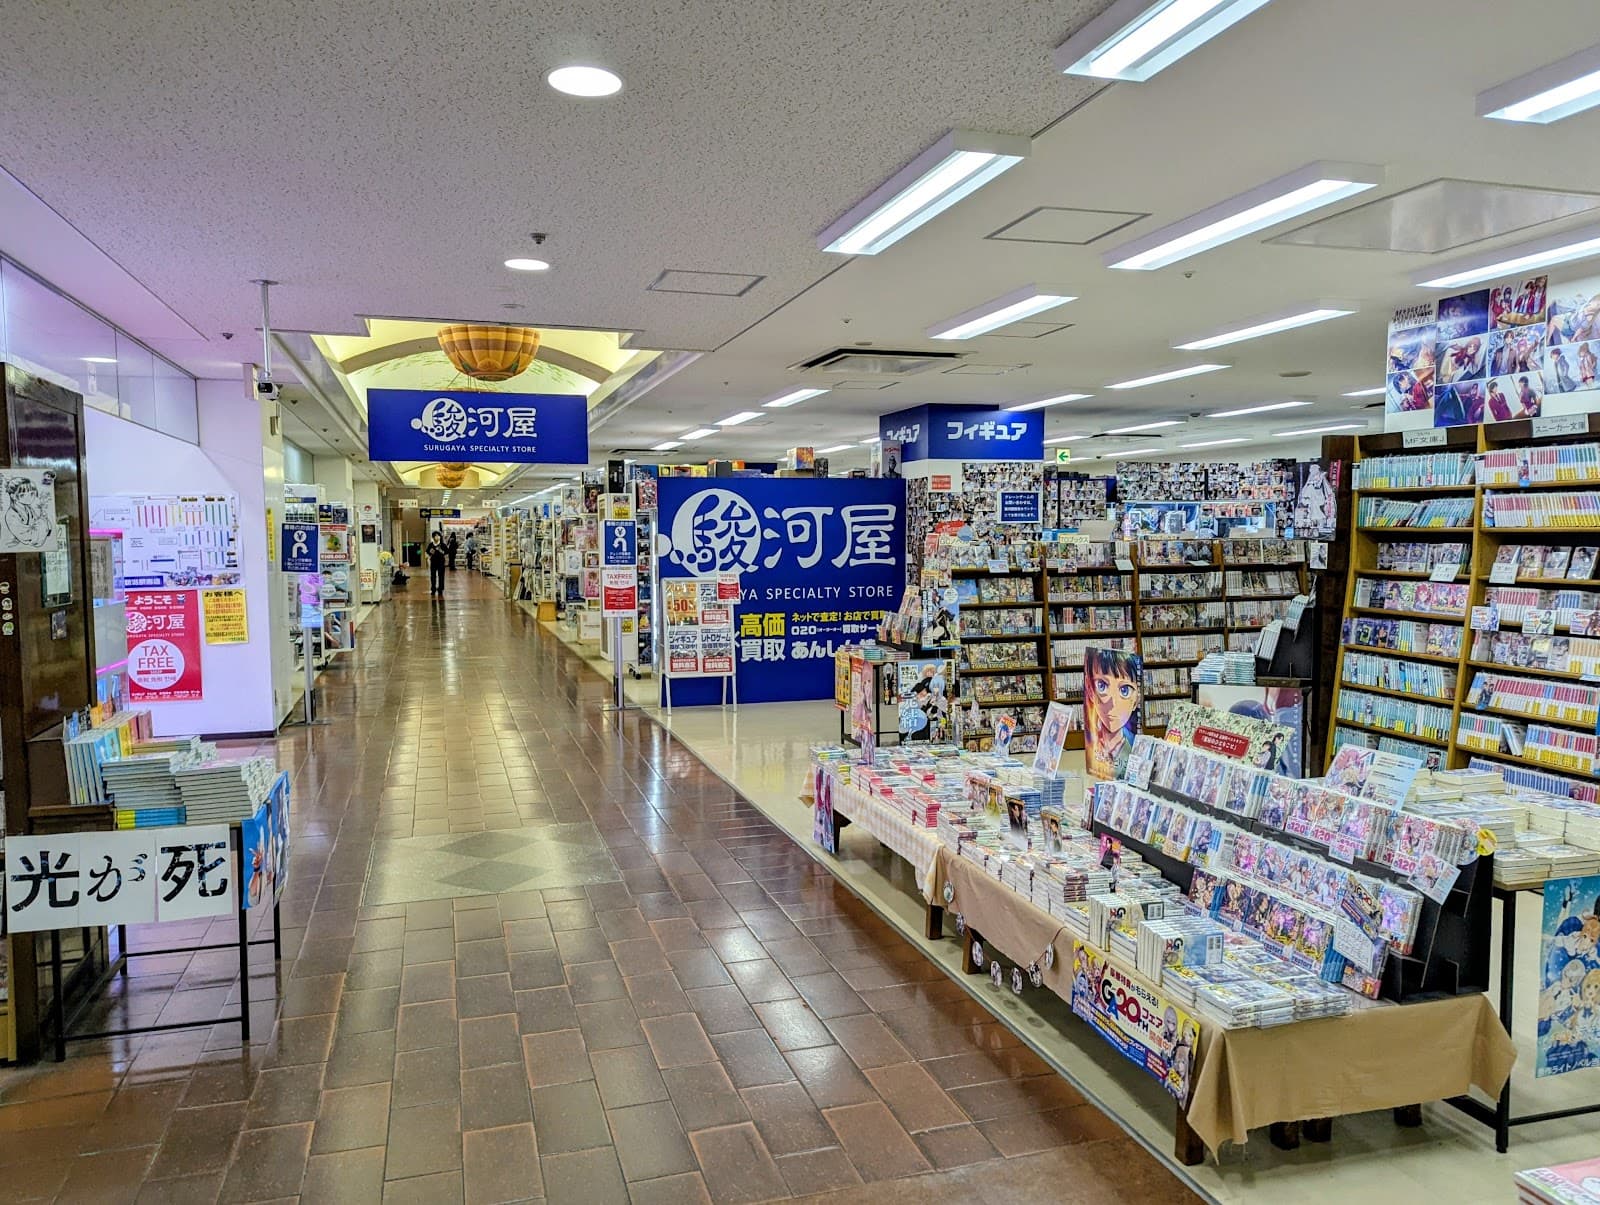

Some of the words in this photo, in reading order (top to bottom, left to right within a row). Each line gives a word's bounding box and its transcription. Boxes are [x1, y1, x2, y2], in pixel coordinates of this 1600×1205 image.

[411, 398, 537, 442] 駿河屋
[1535, 421, 1586, 433] スニーカー文庫
[946, 421, 1028, 441] フィギュア
[1404, 437, 1445, 445] MF文庫J
[423, 444, 466, 452] SURUGAYA
[469, 445, 509, 453] SPECIALTY
[664, 488, 897, 579] 駿河屋
[134, 594, 172, 605] ようこそ
[766, 586, 841, 600] SPECIALTY
[848, 585, 894, 598] STORE
[126, 611, 185, 634] 駿河屋
[791, 611, 842, 622] ネットで査定!
[740, 612, 786, 638] 高価
[701, 632, 730, 642] レトロゲーム
[142, 645, 168, 656] TAX
[740, 638, 786, 662] 買取
[138, 657, 174, 669] FREE
[1399, 859, 1416, 872] 120
[11, 841, 229, 912] 光が死
[1142, 1007, 1163, 1029] フェア
